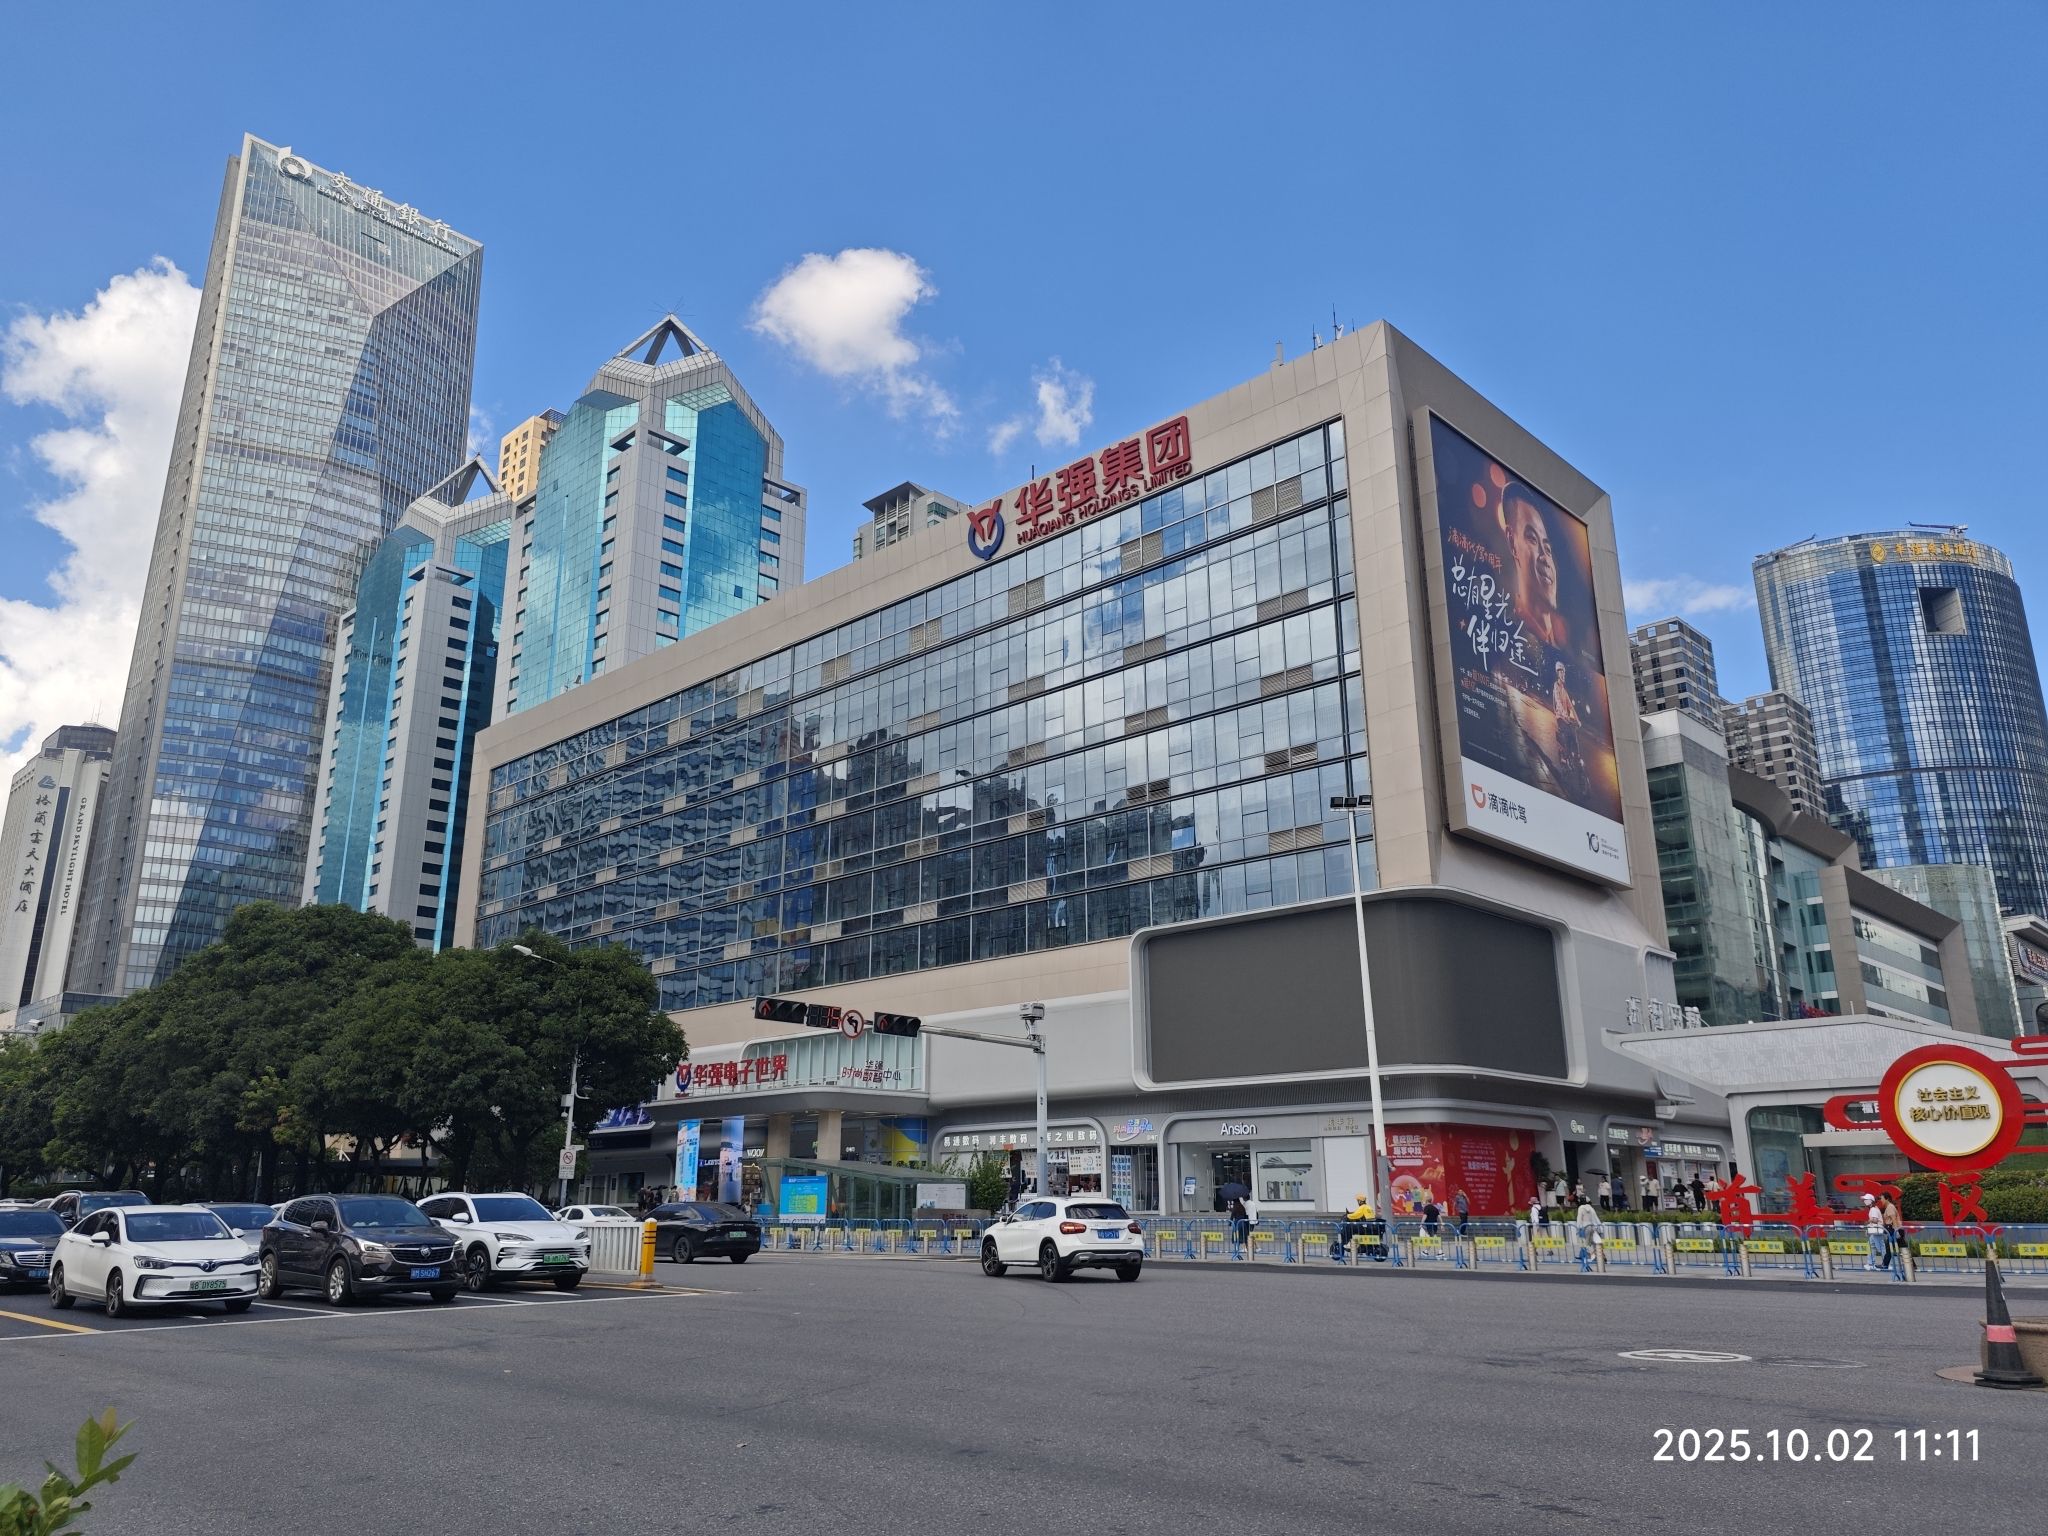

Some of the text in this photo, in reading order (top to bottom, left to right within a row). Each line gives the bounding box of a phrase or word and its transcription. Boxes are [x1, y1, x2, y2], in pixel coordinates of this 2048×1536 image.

[317, 184, 462, 256] BANK OF COMMUNICATIONS
[1014, 415, 1191, 526] 华强集团
[1016, 461, 1192, 545] HUAQIANG HOLDINGS LIMITED
[1451, 554, 1512, 626] 总有星光
[1467, 614, 1538, 676] 伴归途
[1488, 792, 1527, 823] 滴滴代驾
[60, 797, 87, 916] GRAND SKYLIGHT HOTEL
[694, 1054, 788, 1088] 华强电子世界
[1917, 1085, 1981, 1102] 社会主义
[1220, 1122, 1258, 1136] Ansion
[1909, 1103, 1991, 1123] 核心价值观
